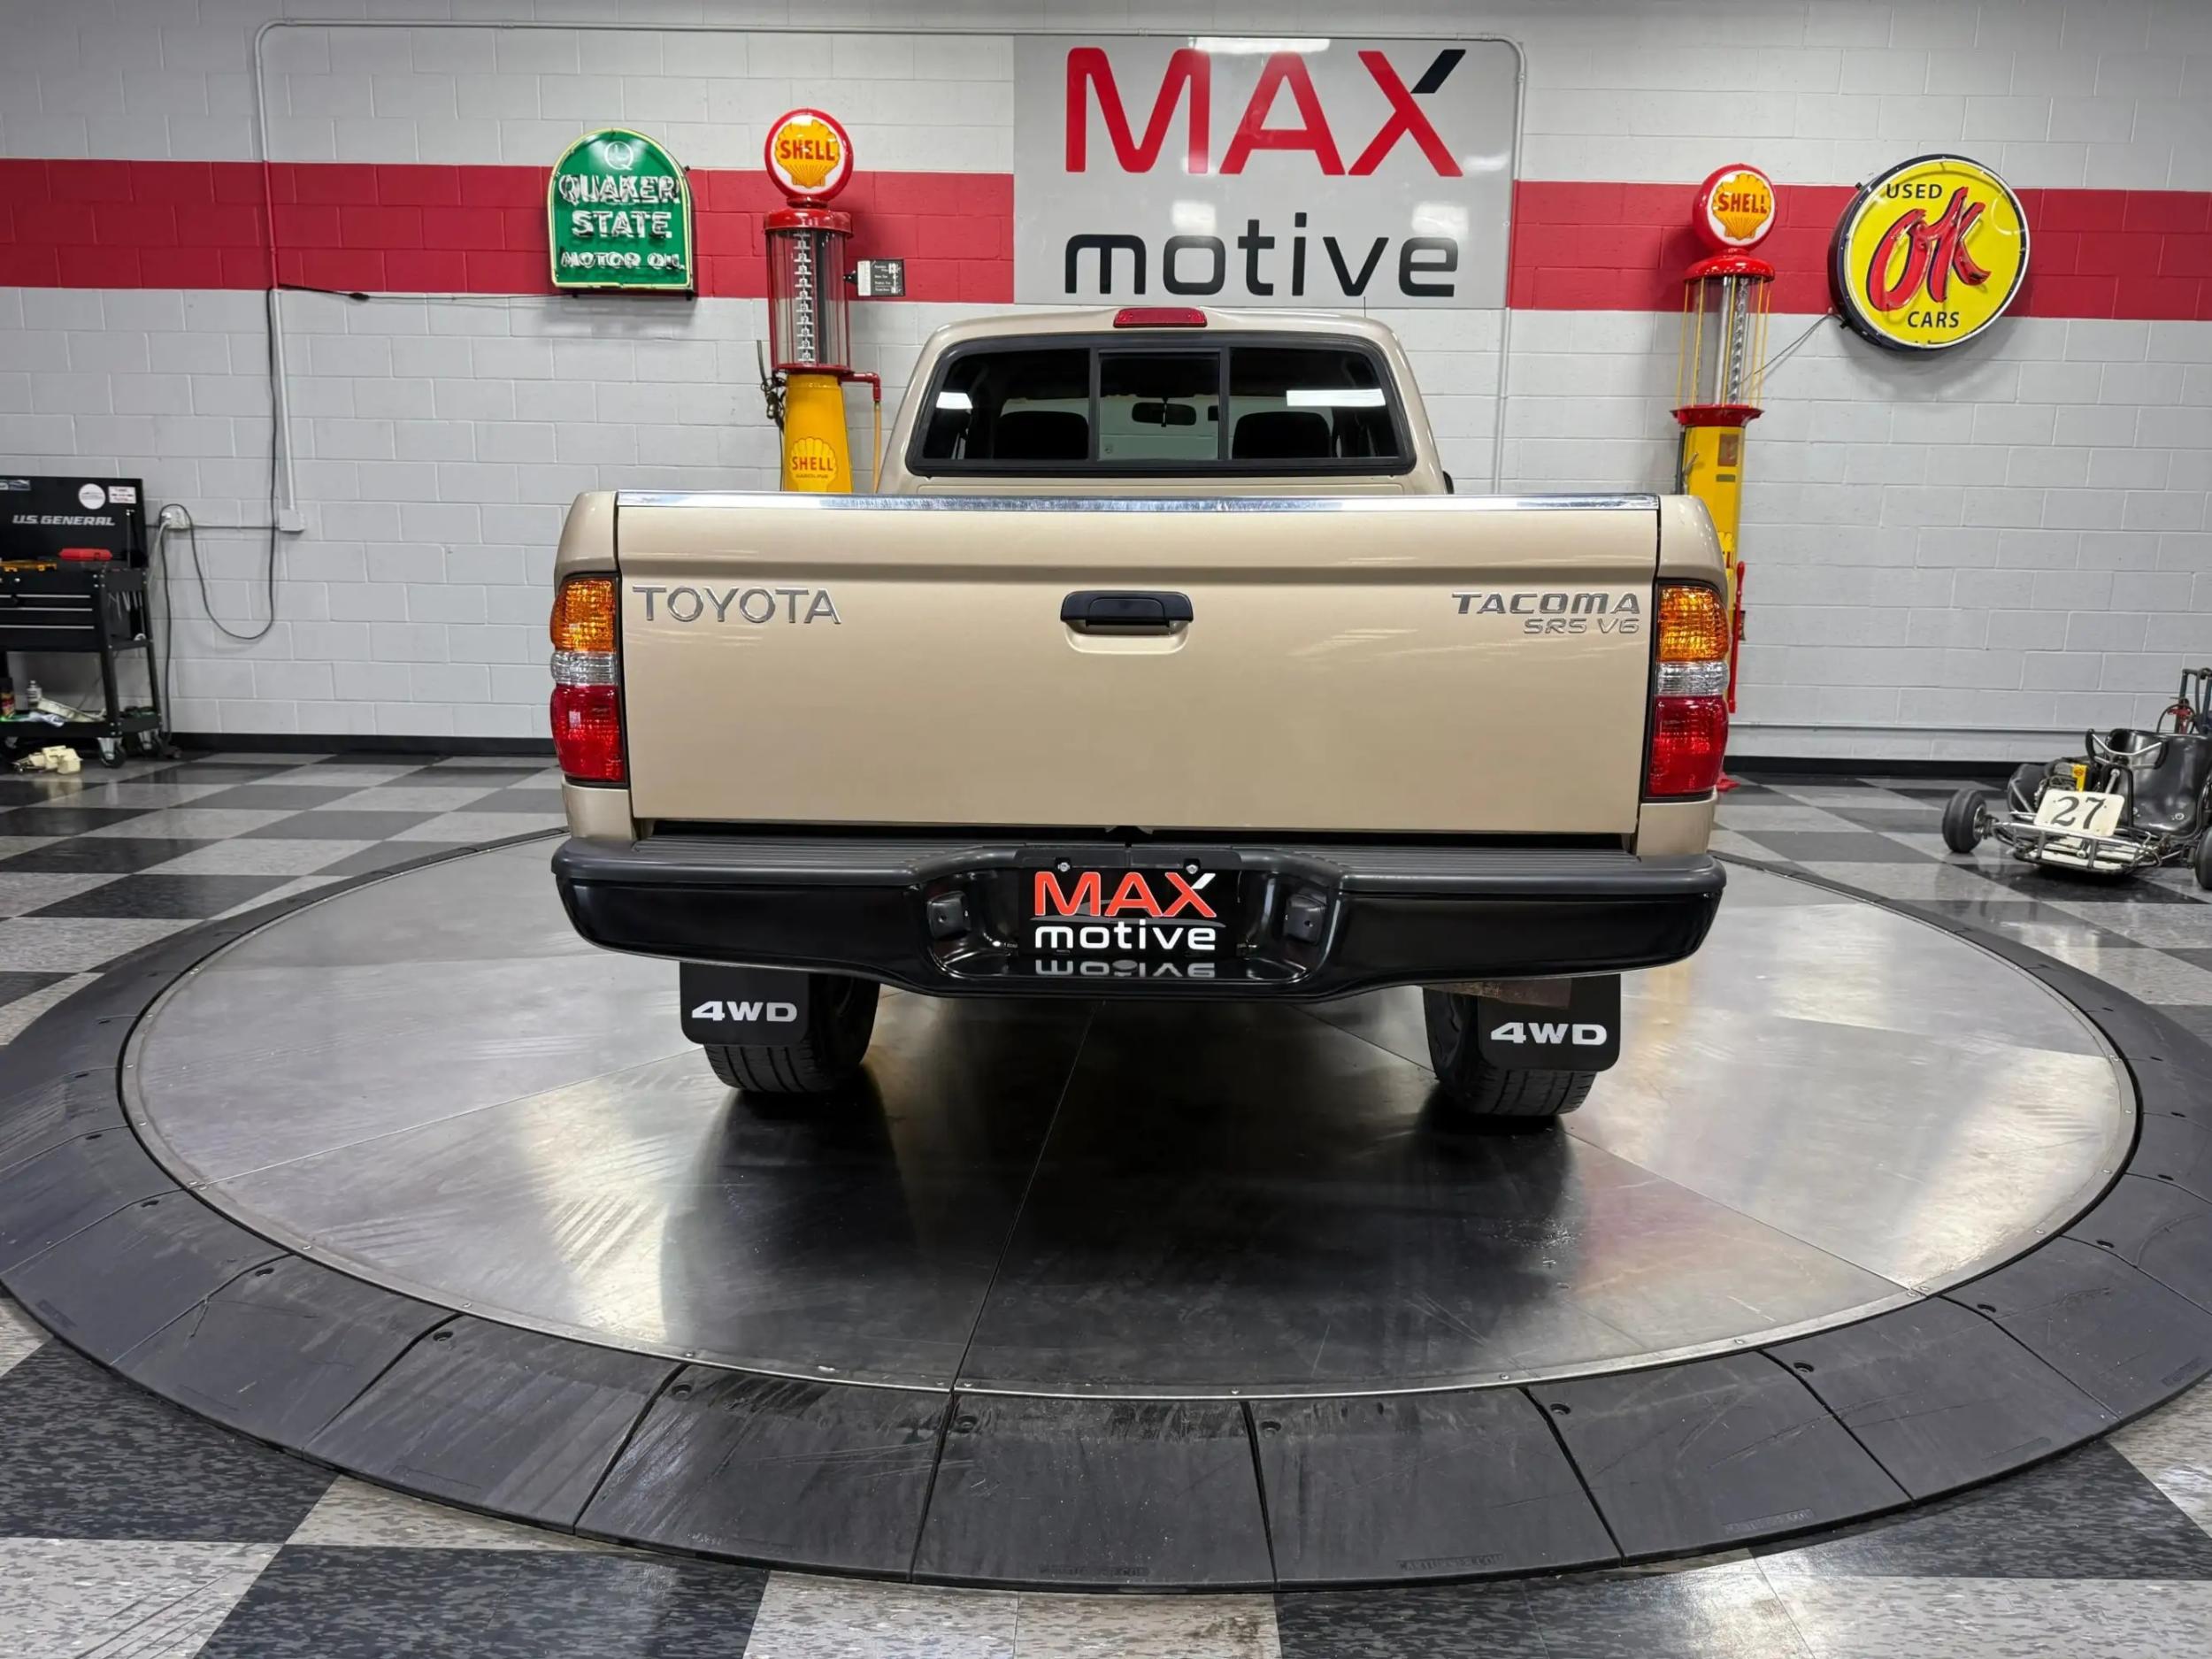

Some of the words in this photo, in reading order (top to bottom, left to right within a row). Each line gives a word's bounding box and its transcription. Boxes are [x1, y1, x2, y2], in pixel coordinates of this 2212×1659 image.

[1065, 47, 1467, 177] MAX
[780, 139, 836, 161] SHELL
[558, 173, 681, 205] QUAKER
[1886, 183, 1943, 199] USED
[1717, 191, 1768, 214] SHELL
[572, 210, 673, 239] STATE
[560, 251, 641, 270] MOTOR
[1064, 212, 1459, 297] motive
[1866, 186, 1992, 312] OK
[1908, 311, 1960, 328] CARS
[792, 457, 833, 472] SHELL
[40, 516, 115, 526] GENERAL
[633, 584, 841, 625] TOYOTA
[1451, 592, 1640, 615] TACOMA
[1524, 618, 1587, 634] SR5
[1598, 618, 1640, 634] V6
[2051, 795, 2107, 830] 27
[1034, 871, 1217, 918] MAX
[1034, 918, 1217, 951] motive
[692, 1001, 798, 1023] 4WD
[1490, 1022, 1608, 1046] 4WD
